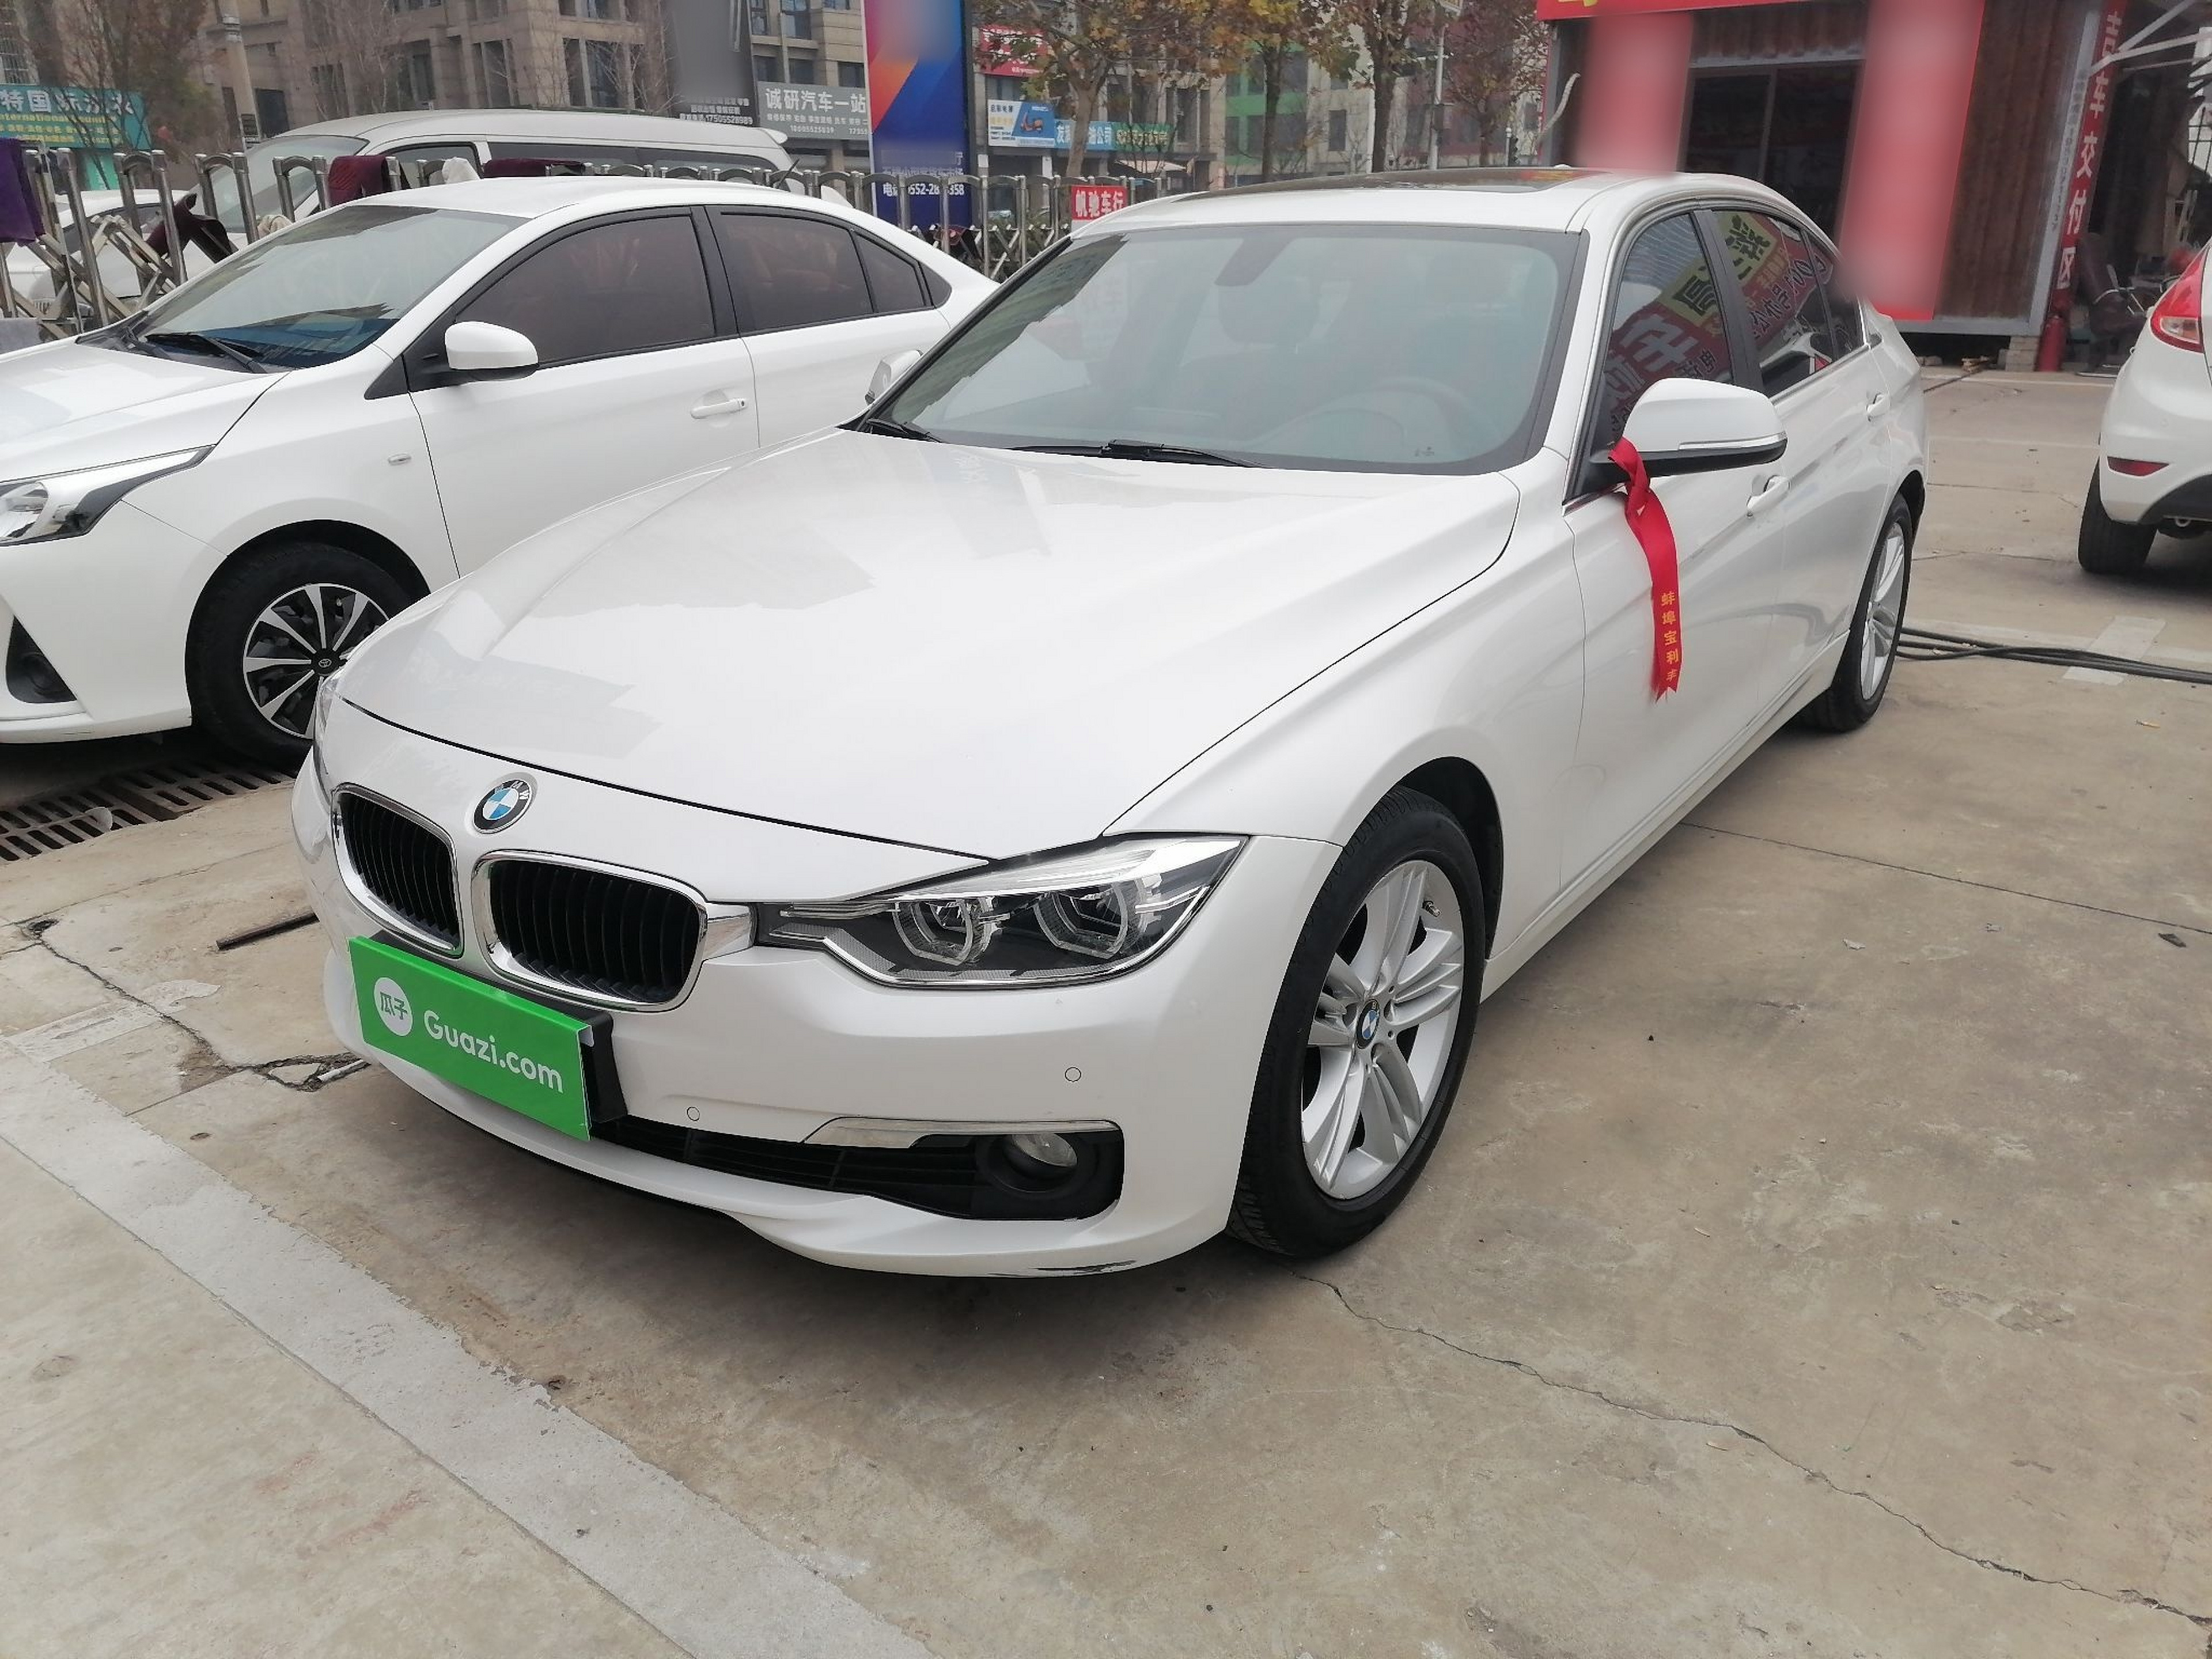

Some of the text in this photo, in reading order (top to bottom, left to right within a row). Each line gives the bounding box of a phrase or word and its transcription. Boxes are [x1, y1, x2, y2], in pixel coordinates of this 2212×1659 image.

[765, 88, 866, 113] 诚研汽车一站
[380, 991, 408, 1021] 瓜子
[423, 1010, 564, 1094] Guazi.com
